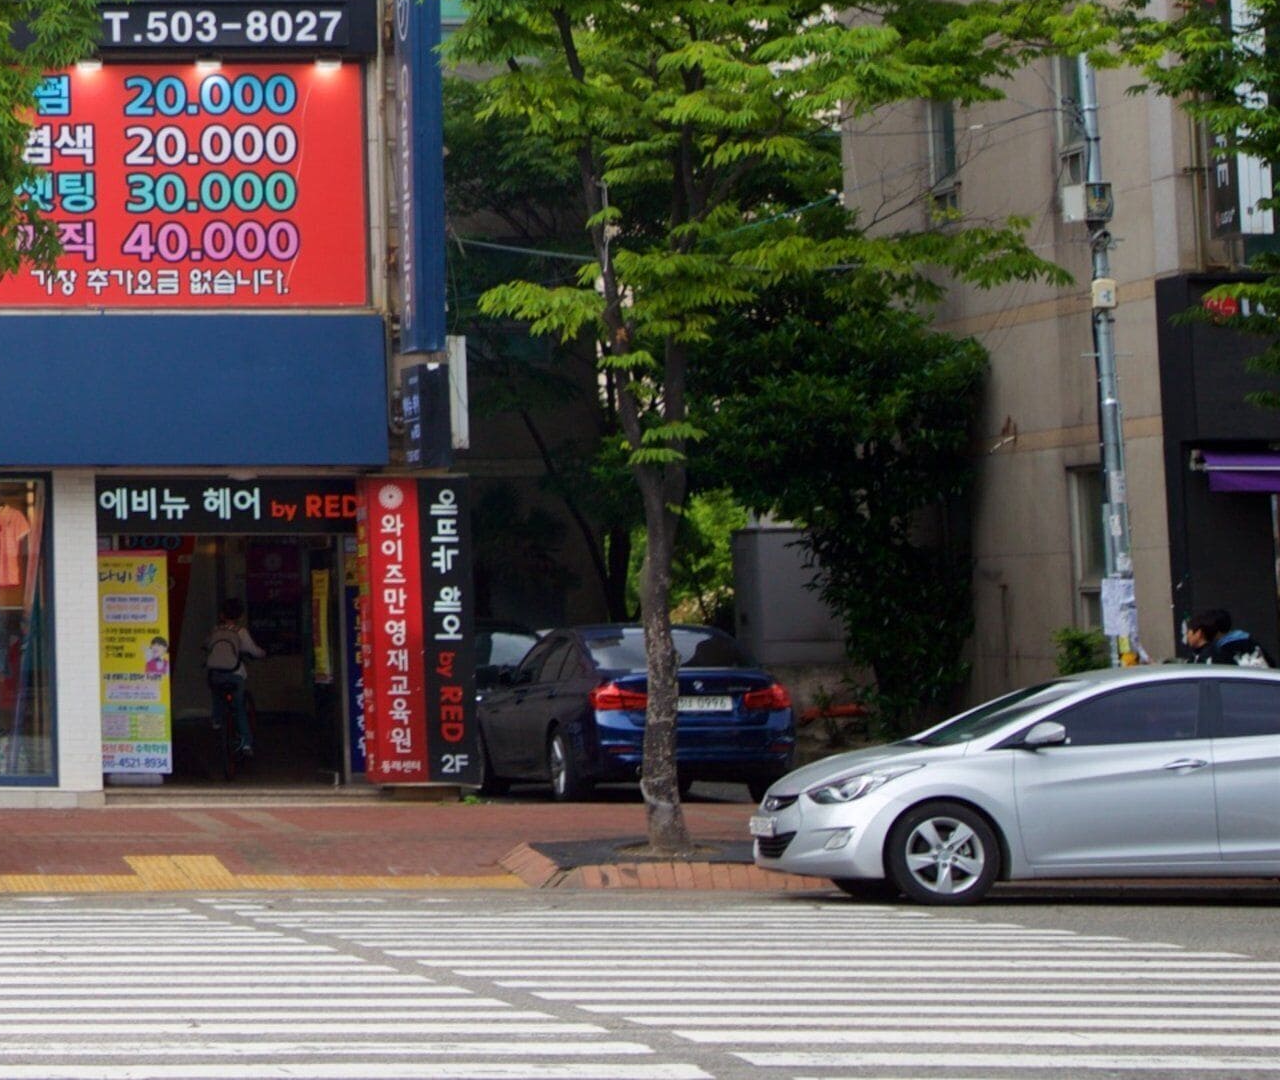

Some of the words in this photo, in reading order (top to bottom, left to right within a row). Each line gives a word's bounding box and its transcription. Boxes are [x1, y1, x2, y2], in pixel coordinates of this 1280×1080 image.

[104, 10, 342, 43] T.503-8027
[123, 74, 298, 117] 20.000
[124, 124, 298, 166] 20.000
[125, 171, 298, 213] 30.000
[121, 221, 301, 262] 40.000
[86, 268, 180, 296] 추가요금
[189, 267, 290, 295] 없습니다.
[99, 487, 190, 521] 에비뉴
[202, 486, 263, 520] 헤어
[271, 500, 297, 522] by
[305, 494, 360, 518] RED
[430, 488, 460, 575] 에비뉴
[380, 513, 412, 754] 와이즈만영재교육원
[434, 585, 463, 641] 헤어
[440, 685, 466, 743] RED
[440, 754, 469, 774] 2F
